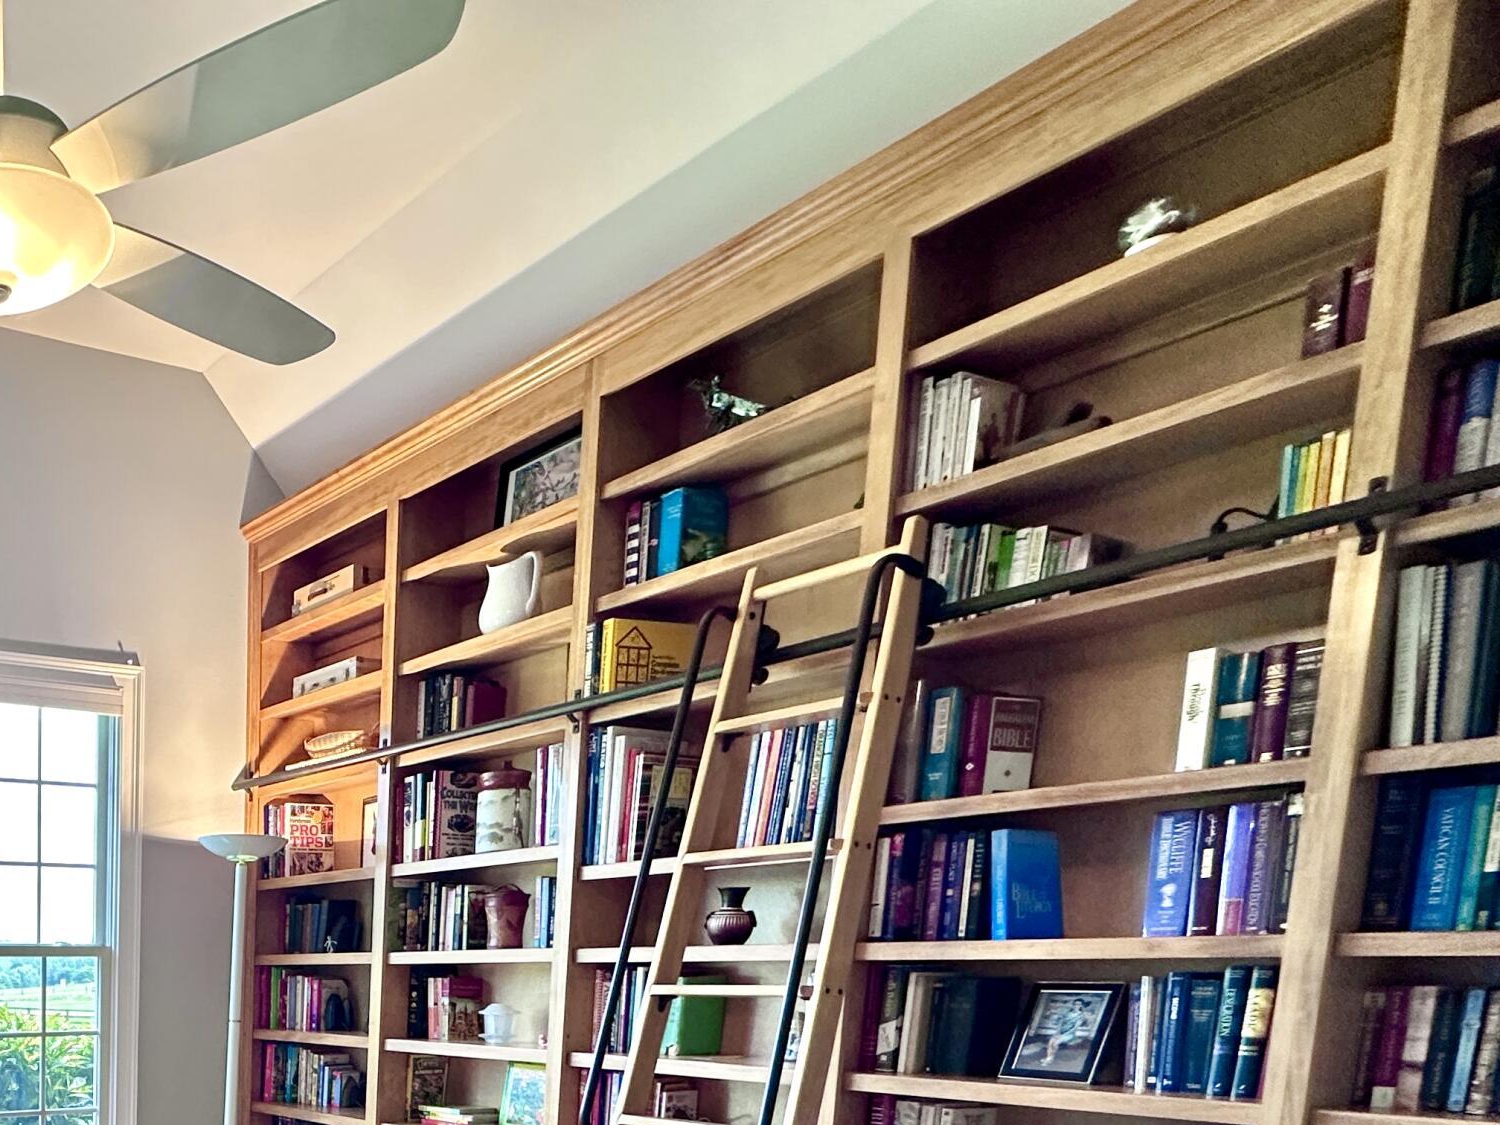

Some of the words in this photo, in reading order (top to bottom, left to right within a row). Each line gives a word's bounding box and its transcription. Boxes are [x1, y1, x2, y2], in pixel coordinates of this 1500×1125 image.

[289, 823, 320, 837] PRO
[290, 836, 325, 849] TIPS
[1170, 820, 1192, 875] WYCLIFFE
[1436, 806, 1454, 849] VATICAN
[1430, 851, 1449, 895] COUNCIL
